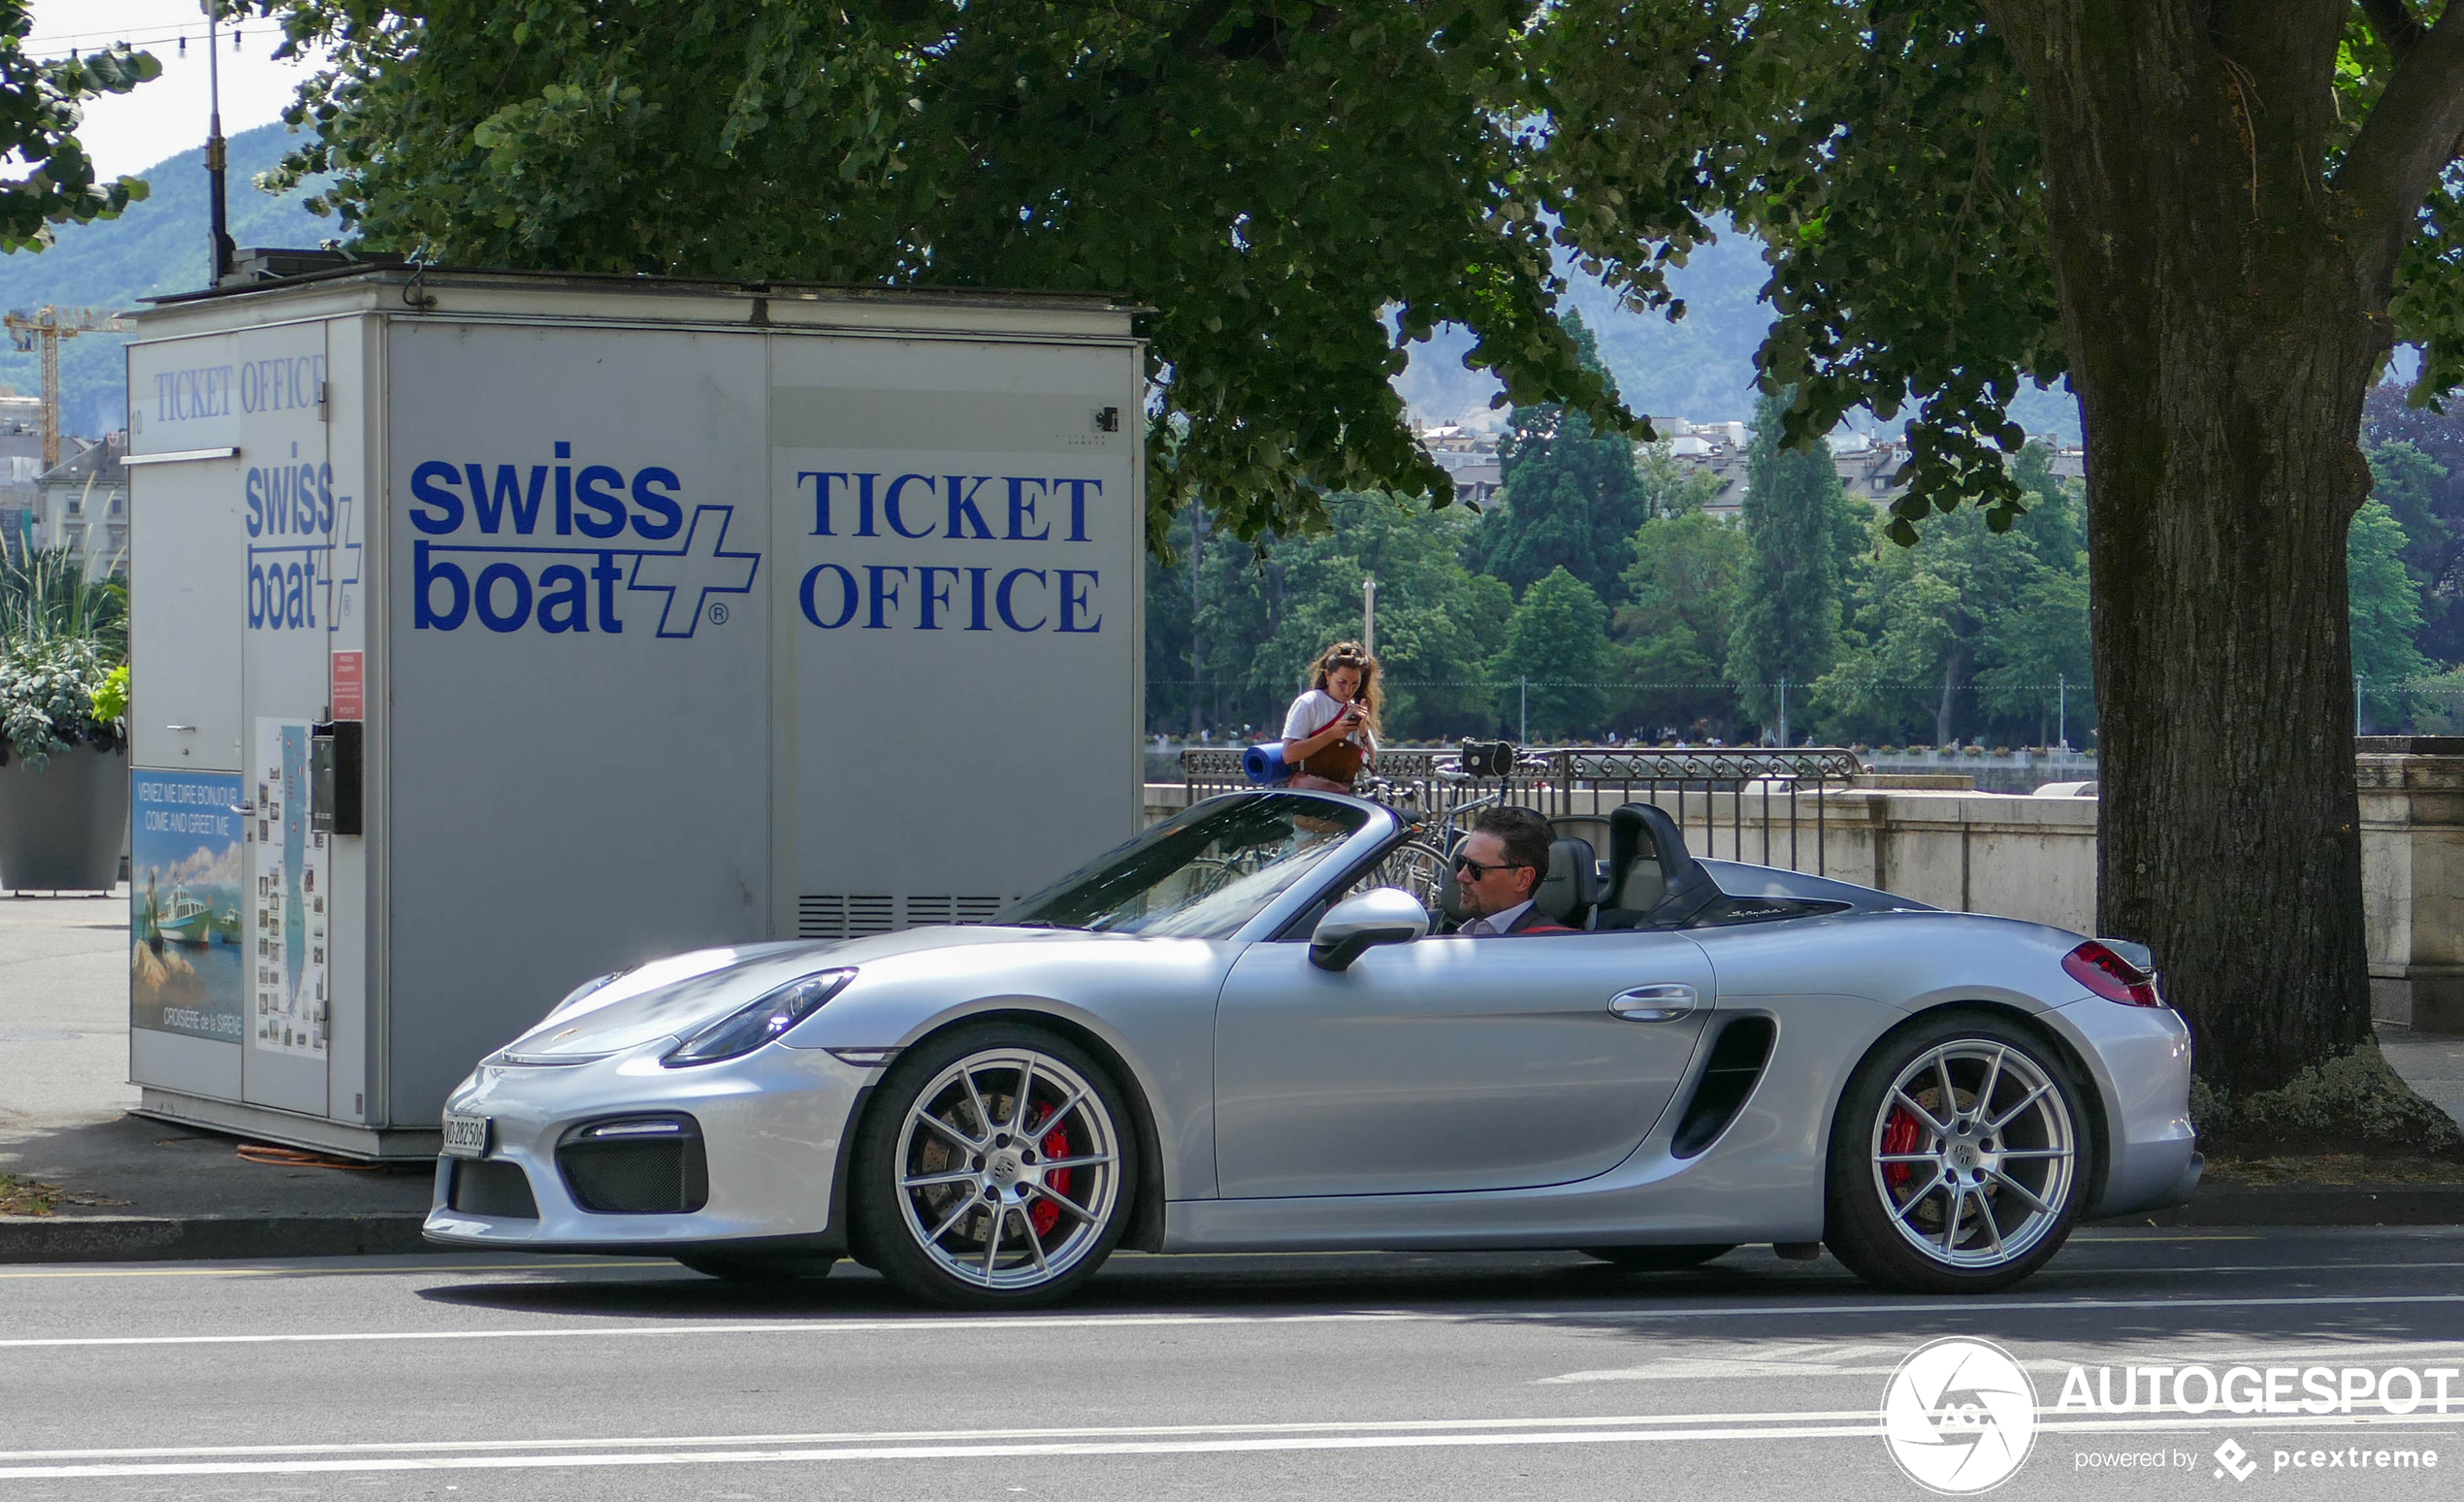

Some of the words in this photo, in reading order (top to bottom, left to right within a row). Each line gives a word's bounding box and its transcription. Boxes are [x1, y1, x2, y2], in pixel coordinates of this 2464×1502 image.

[155, 365, 233, 422] TICKET
[241, 354, 324, 414] OFFICE
[246, 441, 334, 538] swiss
[410, 441, 683, 539] swiss
[798, 472, 1102, 541] TICKET
[248, 543, 315, 630] boat
[413, 539, 623, 634] boat
[799, 564, 1101, 634] OFFICE
[138, 782, 163, 802] VENEZ
[165, 784, 177, 803] ME
[178, 784, 196, 804] DIRE
[198, 785, 237, 806] BONJOUR
[146, 810, 169, 832] COME
[171, 813, 187, 833] AND
[188, 813, 215, 834] GREET
[216, 816, 230, 836] ME
[200, 1013, 209, 1030] de
[210, 1014, 215, 1031] la
